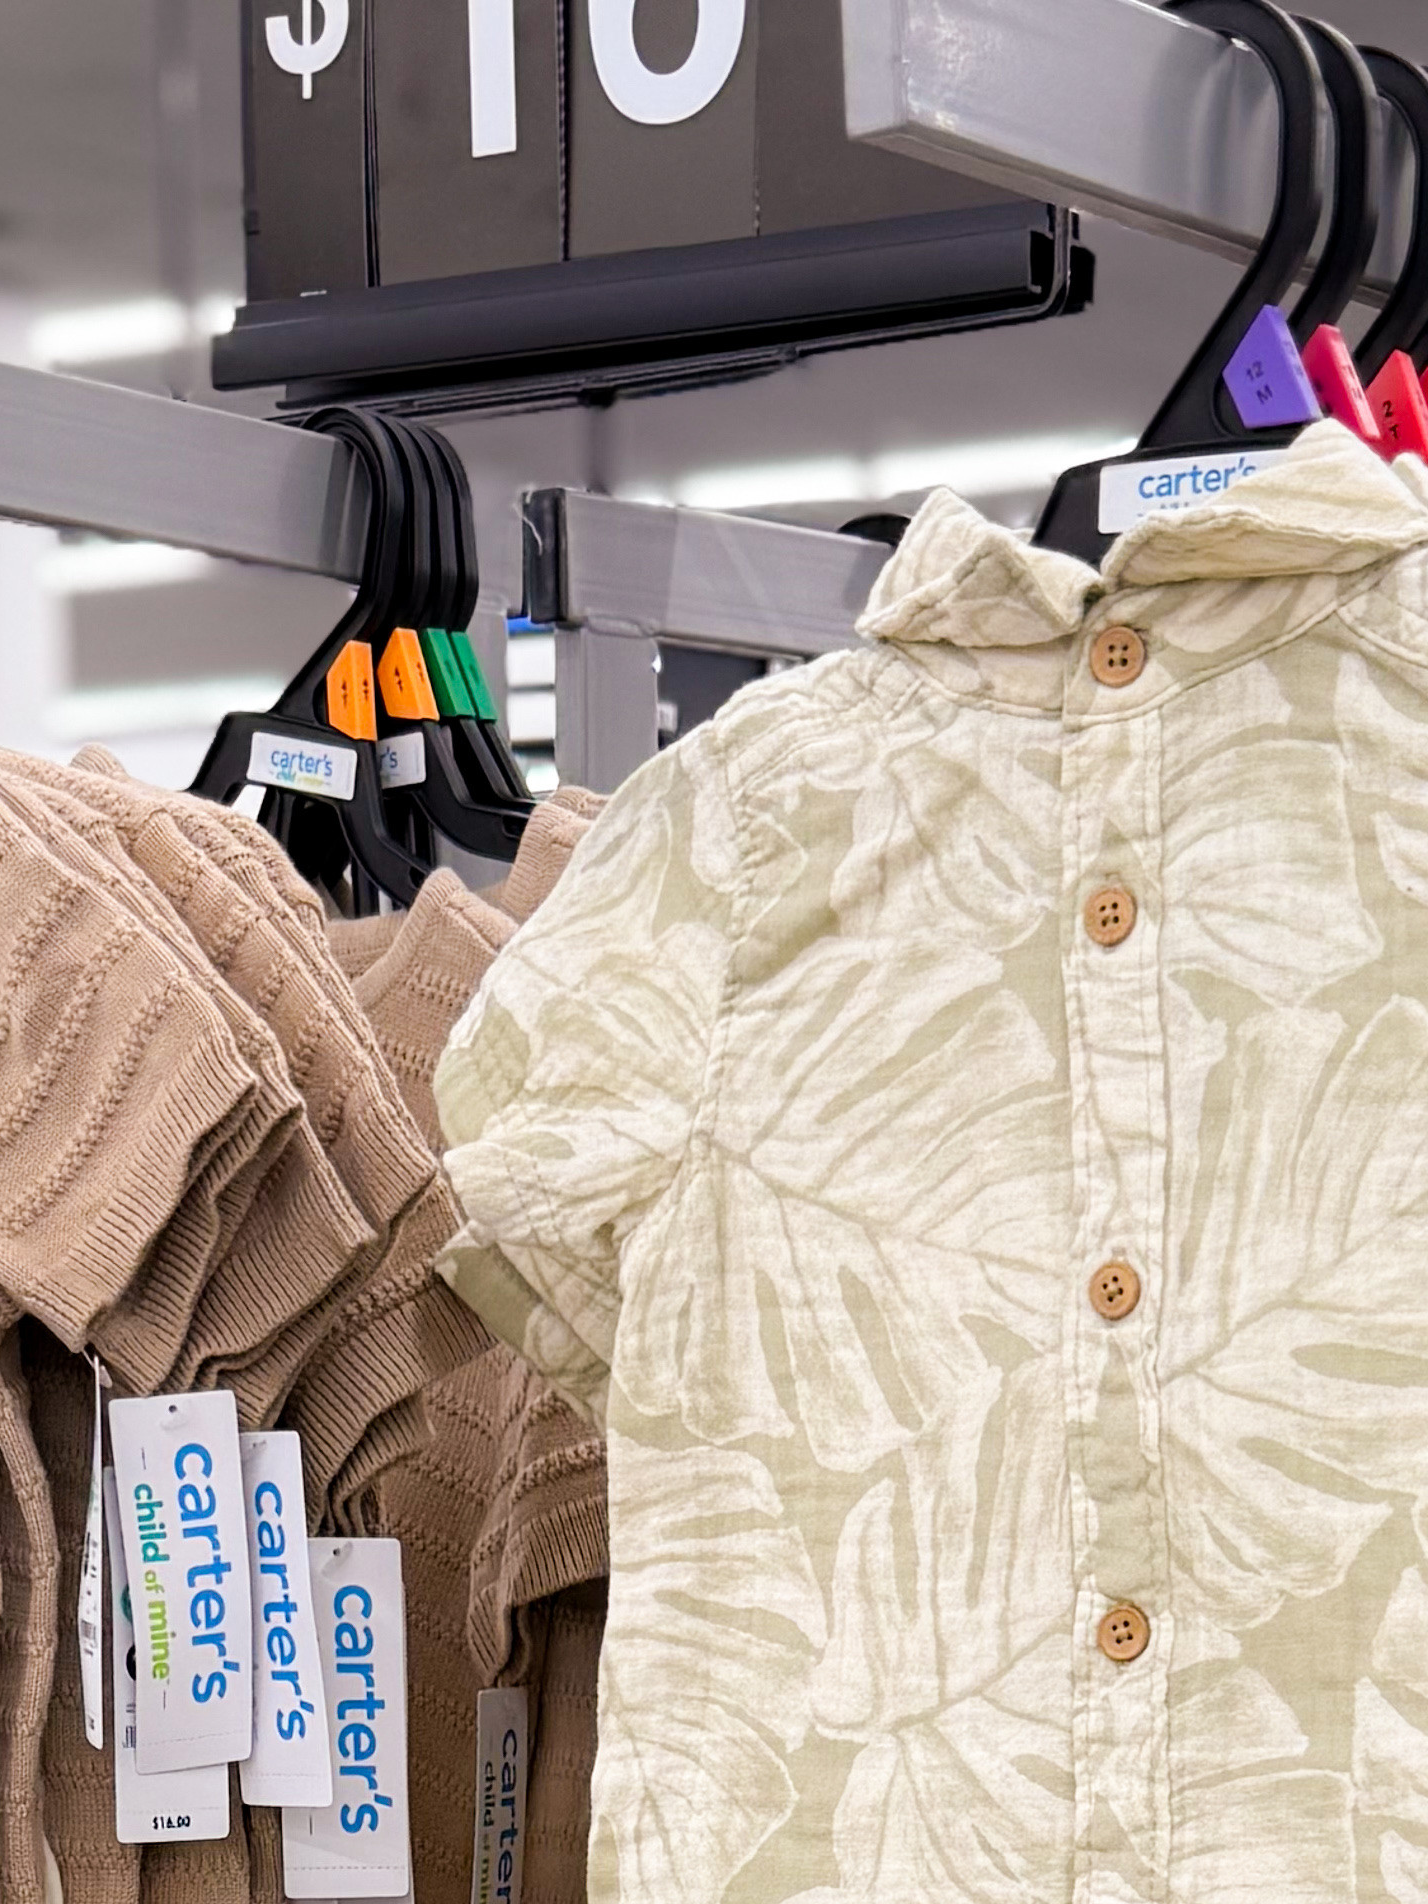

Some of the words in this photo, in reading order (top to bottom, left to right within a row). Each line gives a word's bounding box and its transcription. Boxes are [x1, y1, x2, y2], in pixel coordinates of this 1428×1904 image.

[1246, 360, 1264, 381] 12
[1254, 386, 1273, 405] M
[1382, 400, 1393, 418] 2
[271, 748, 333, 777] carter's
[134, 1484, 170, 1563] child
[144, 1570, 165, 1594] of
[174, 1443, 240, 1703] carter's
[148, 1600, 176, 1680] mine
[254, 1481, 315, 1741] carter's
[333, 1585, 393, 1834] carter's
[484, 1761, 496, 1828] child
